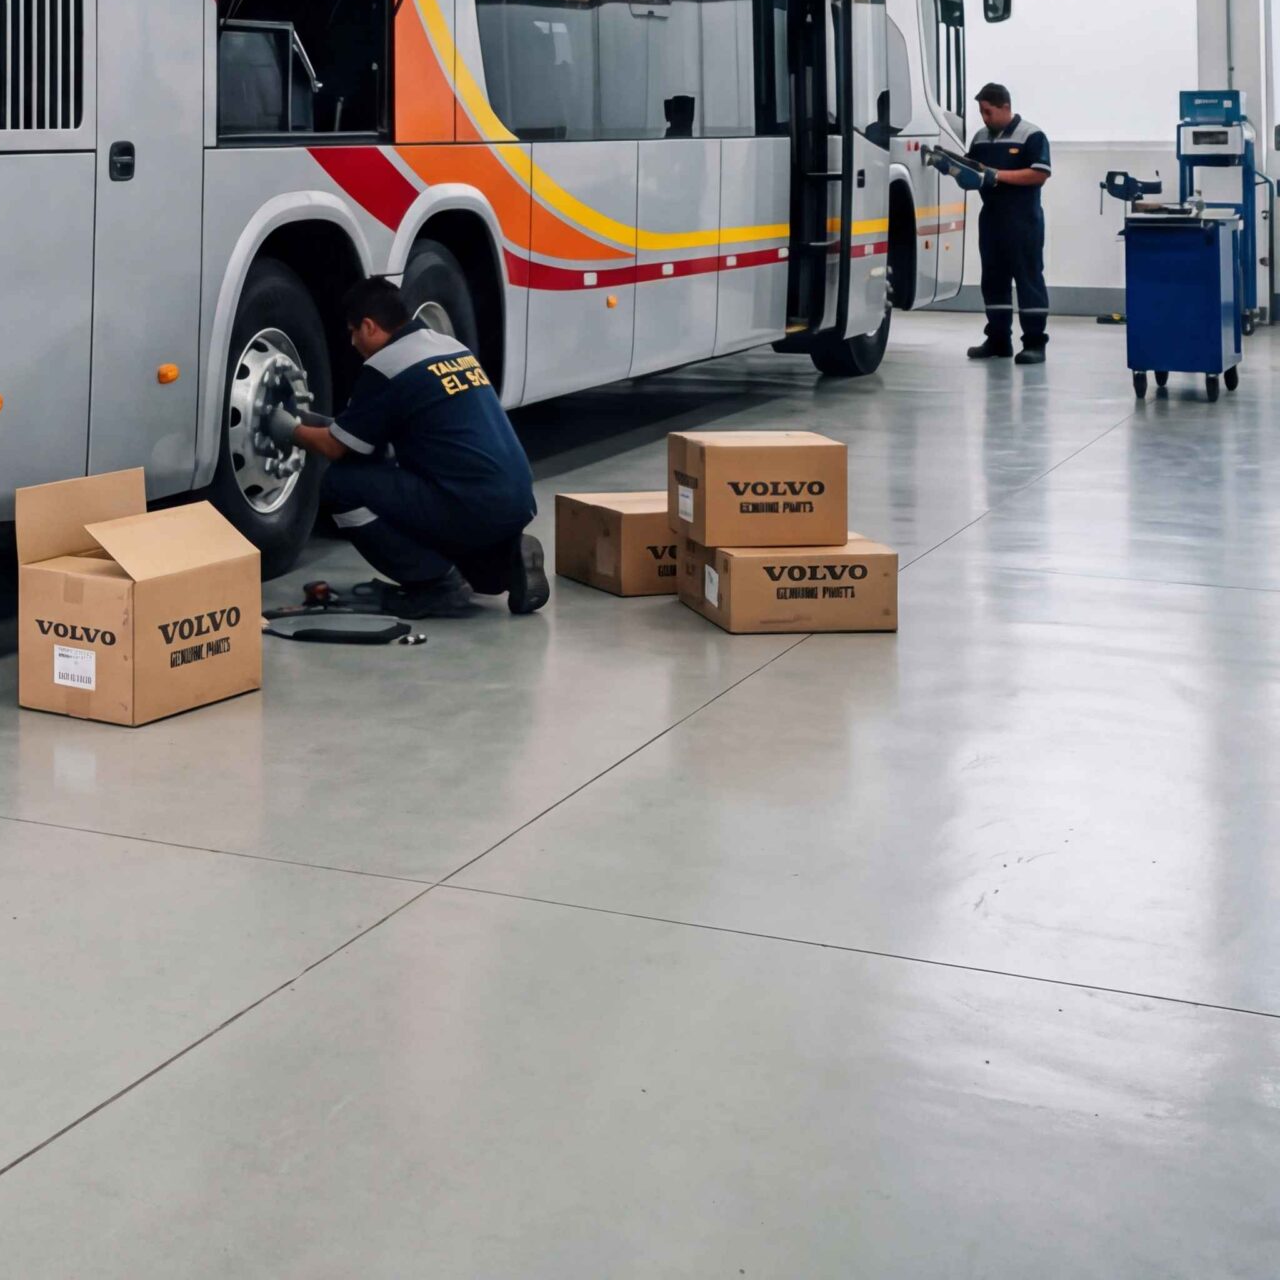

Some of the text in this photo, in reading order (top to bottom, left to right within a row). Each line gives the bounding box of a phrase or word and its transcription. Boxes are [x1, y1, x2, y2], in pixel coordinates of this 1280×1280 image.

[441, 374, 469, 395] EL
[727, 481, 825, 496] VOLVO
[763, 564, 868, 581] VOLVO
[35, 619, 116, 646] VOLVO
[158, 606, 240, 645] VOLVO
